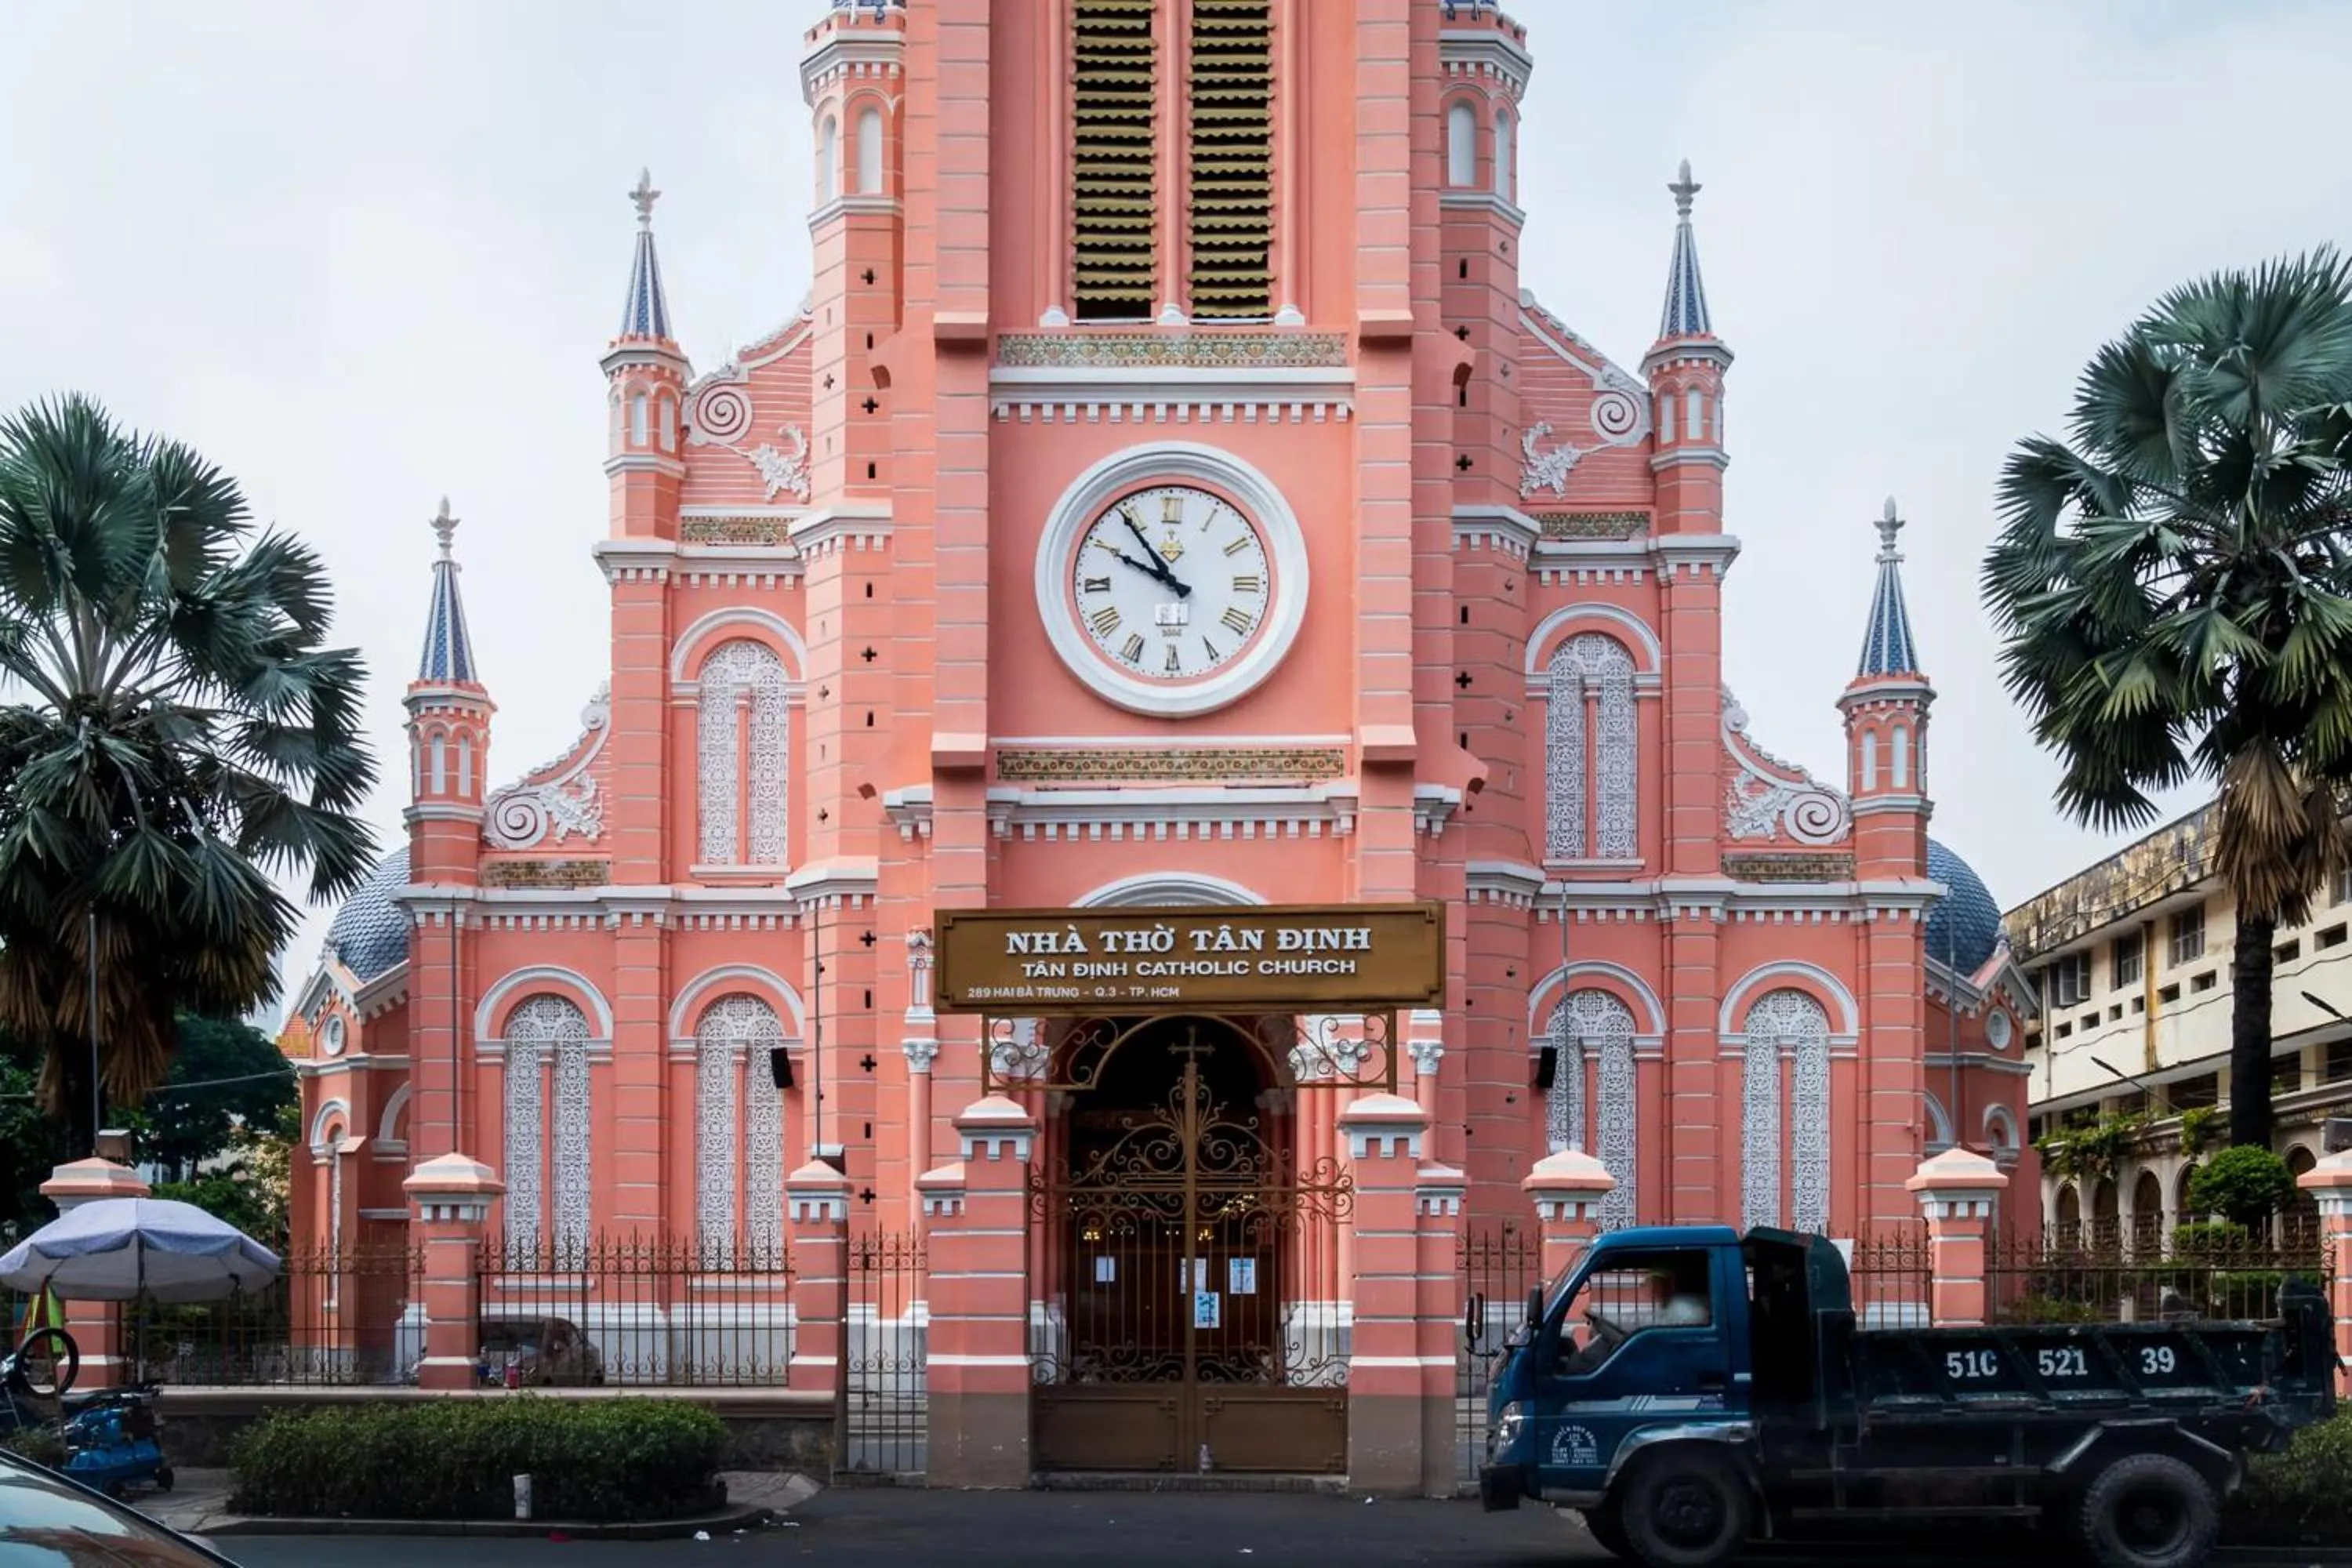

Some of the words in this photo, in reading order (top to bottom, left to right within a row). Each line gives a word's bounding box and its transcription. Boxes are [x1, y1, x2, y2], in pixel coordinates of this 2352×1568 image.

[1232, 576, 1259, 593] III
[1006, 924, 1088, 954] NHÀ
[1098, 923, 1175, 953] THỜ
[1189, 924, 1265, 951] TÂN
[1276, 927, 1371, 955] ĐỊNH
[1021, 960, 1065, 978] TÂN
[1073, 961, 1128, 979] ĐỊNH
[1135, 960, 1250, 976] CATHOLIC
[1258, 959, 1356, 975] CHURCH
[967, 987, 991, 998] 289
[993, 987, 1014, 998] HAI
[1016, 985, 1034, 998] BÀ
[1094, 986, 1116, 998] Q.3
[1150, 986, 1180, 997] HCM
[1946, 1349, 1998, 1378] 51C
[2038, 1347, 2089, 1377] 521
[2140, 1346, 2176, 1374] 39
